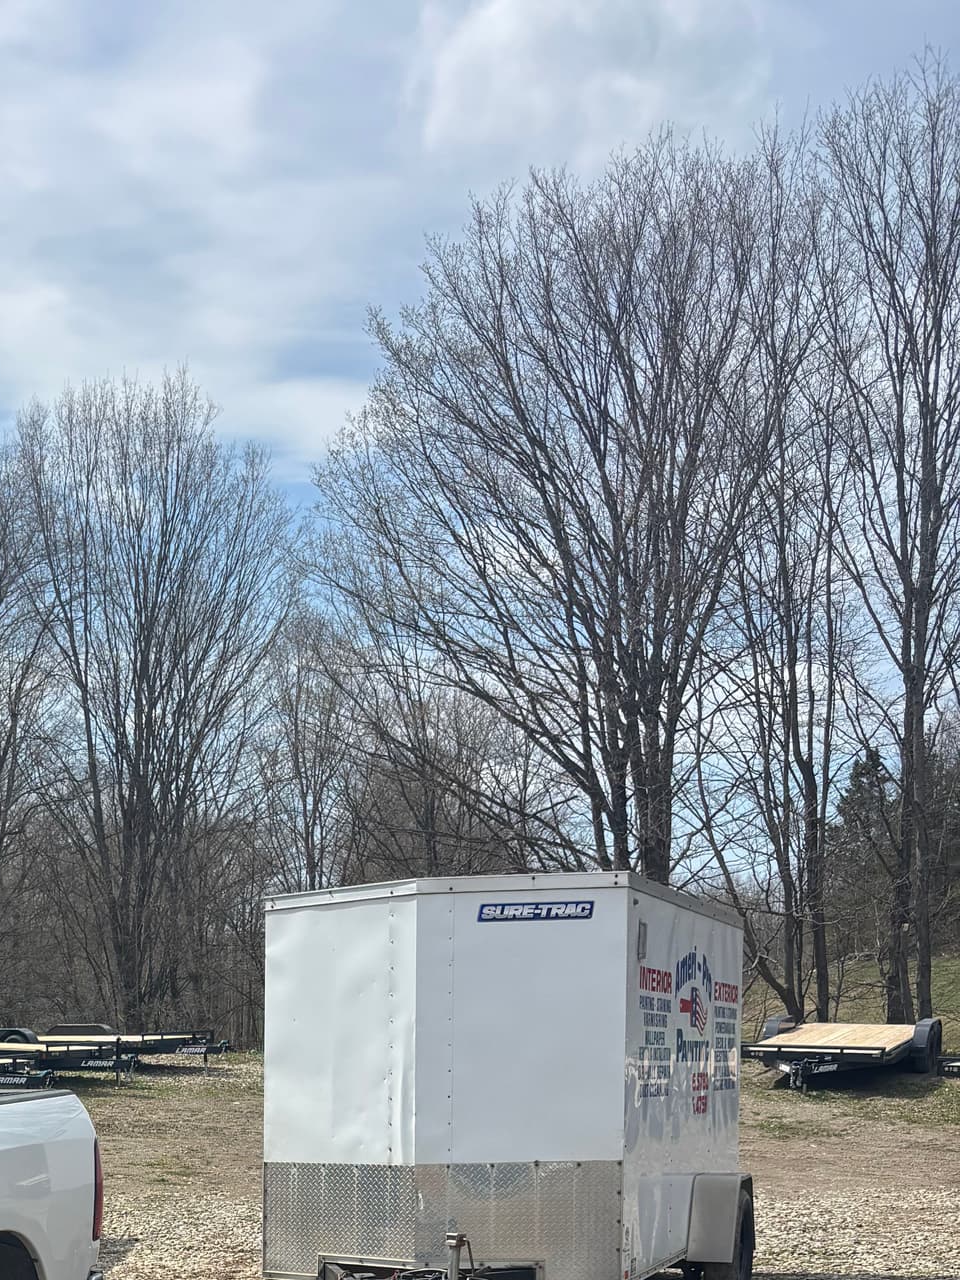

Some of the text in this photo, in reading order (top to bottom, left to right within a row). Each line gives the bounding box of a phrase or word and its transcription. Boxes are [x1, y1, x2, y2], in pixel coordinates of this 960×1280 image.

[481, 903, 591, 919] SURE-TRAC
[639, 965, 672, 995] INTERIOR
[714, 981, 738, 1004] EXTERIOR
[176, 1047, 207, 1055] LAMAR
[81, 1060, 114, 1068] LAMAR
